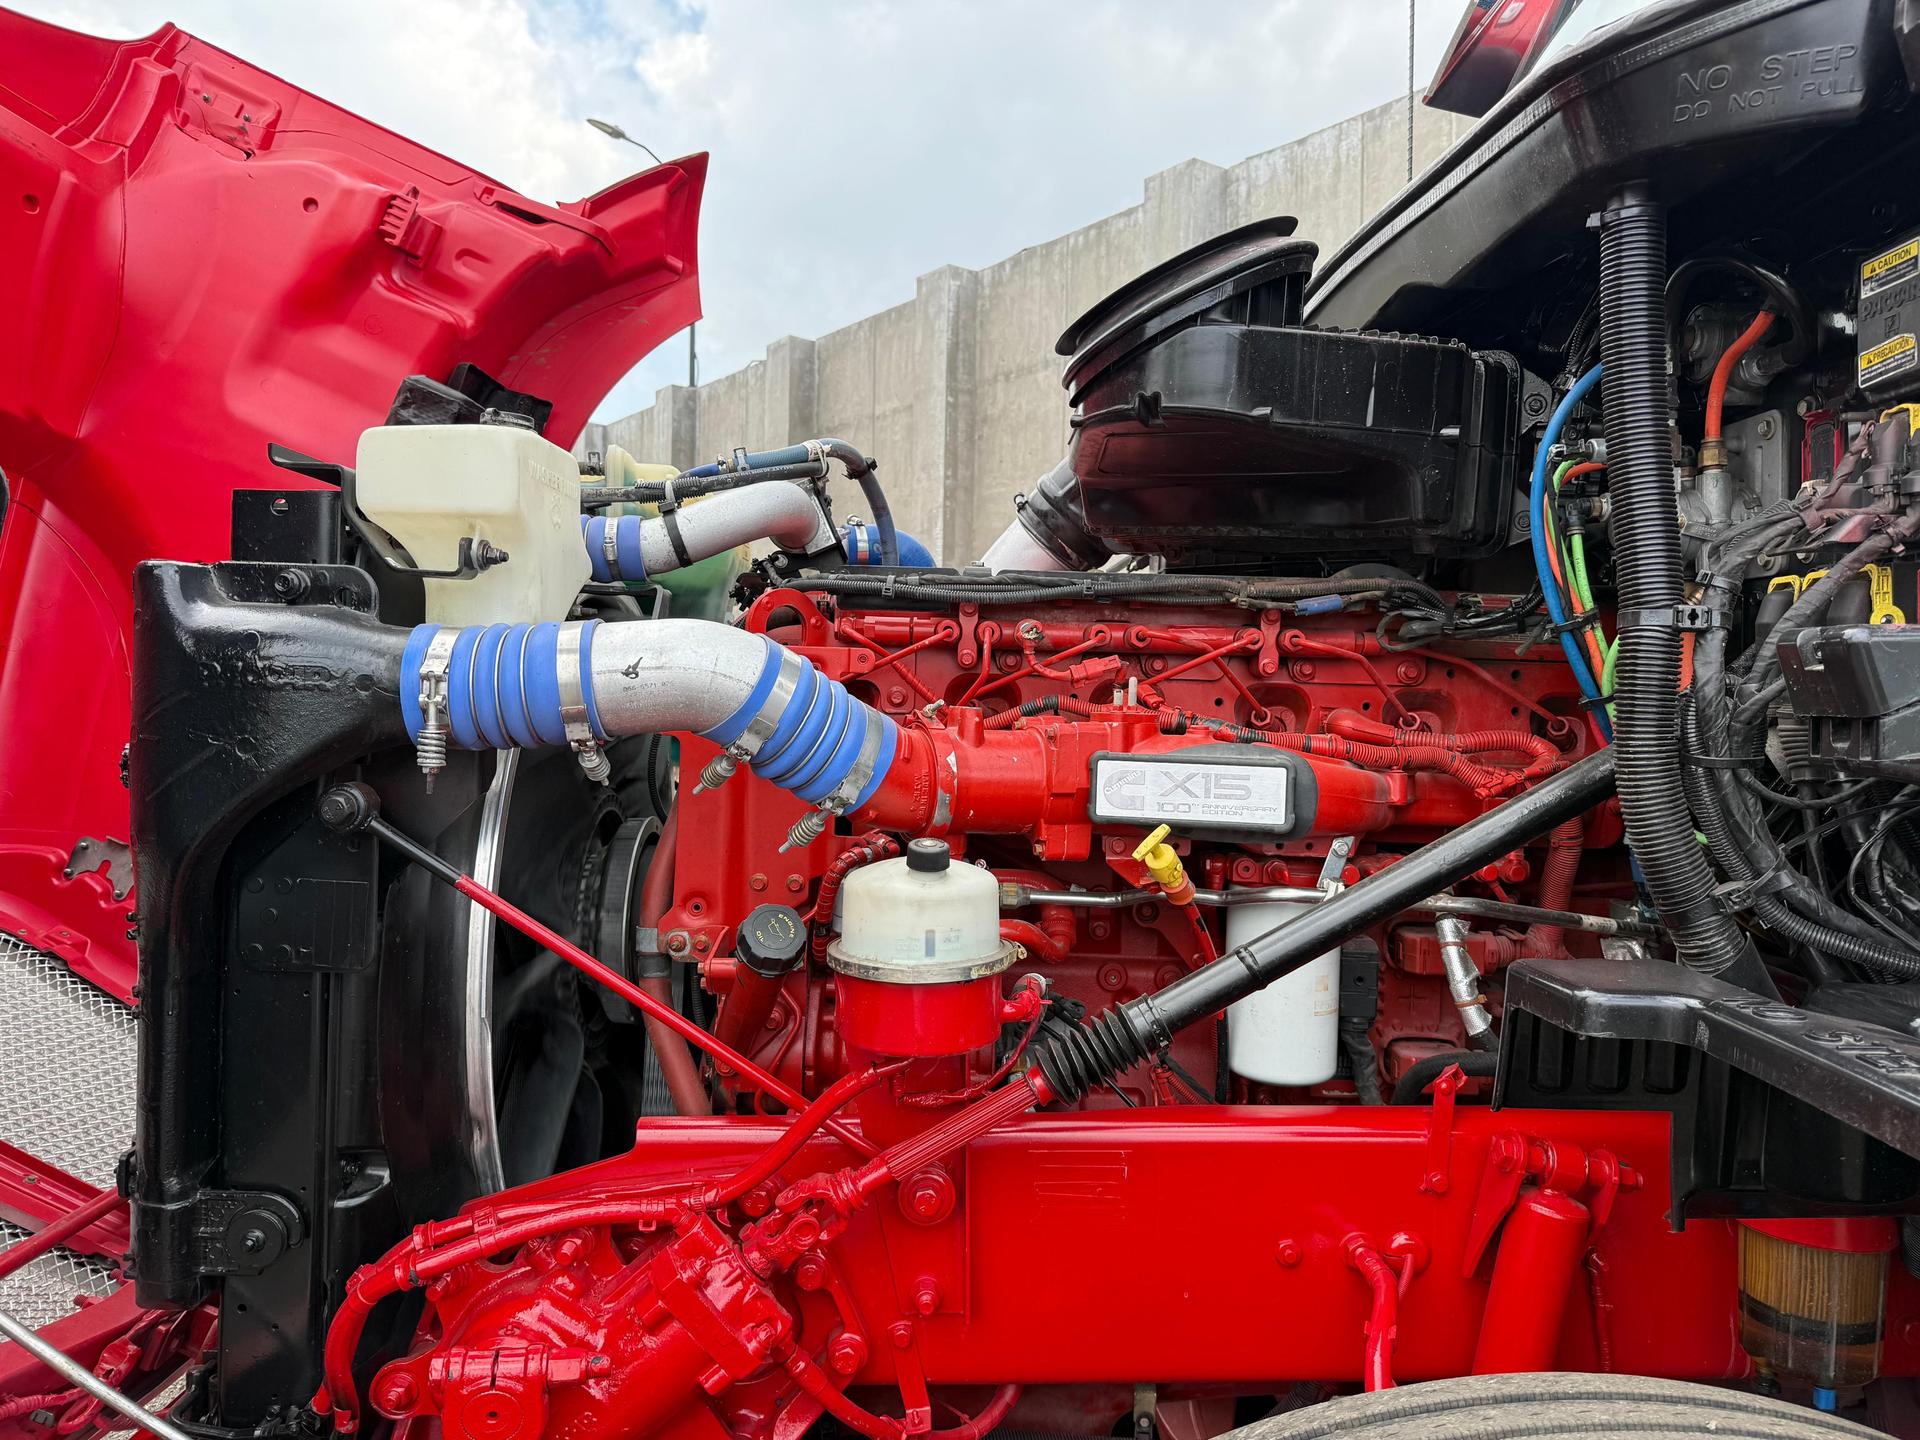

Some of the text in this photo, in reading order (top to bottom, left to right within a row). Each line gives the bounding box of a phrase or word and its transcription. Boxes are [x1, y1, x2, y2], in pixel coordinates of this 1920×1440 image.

[1676, 44, 1858, 97] NO STEP
[1672, 76, 1865, 123] DO NOT PULL
[1877, 246, 1912, 270] CAUTION
[1159, 770, 1252, 801] X15
[1202, 803, 1278, 813] ANNIVERSARY
[756, 930, 764, 942] OIL
[778, 913, 795, 938] ENGINE
